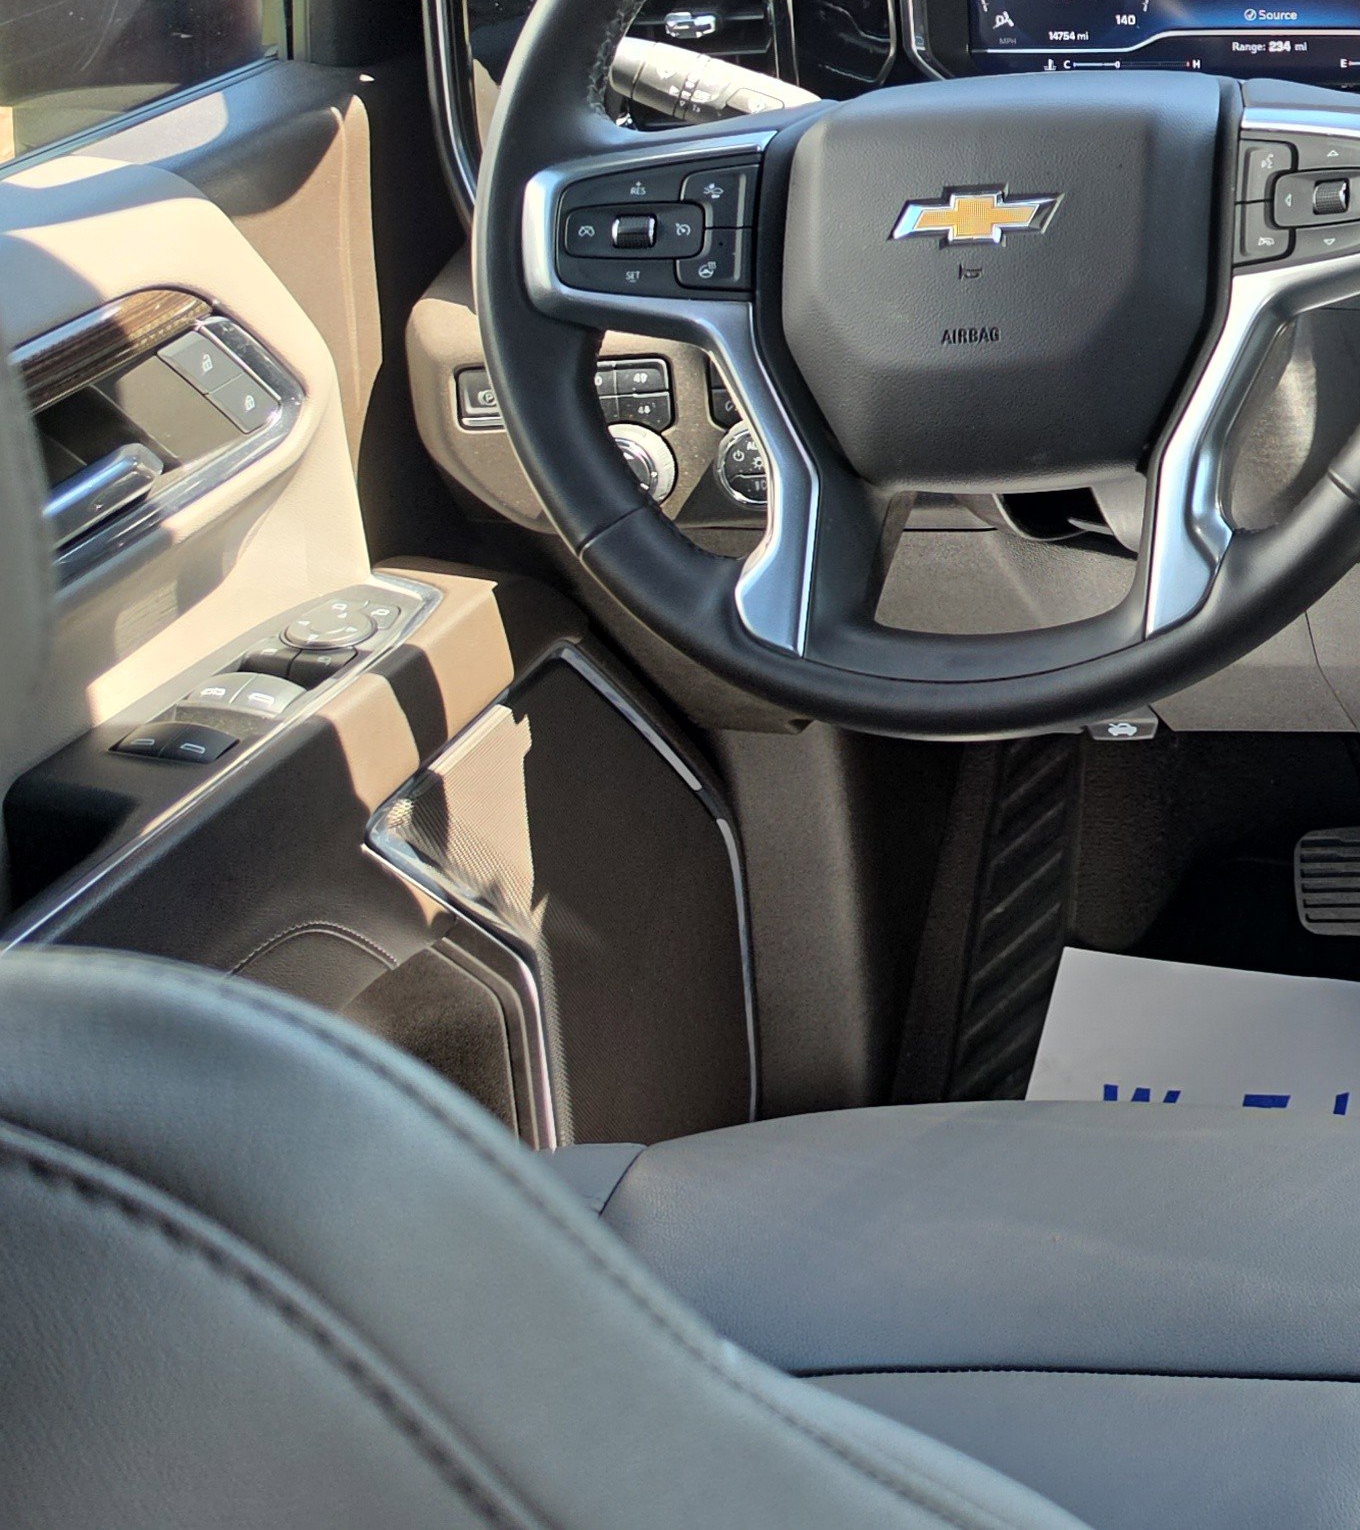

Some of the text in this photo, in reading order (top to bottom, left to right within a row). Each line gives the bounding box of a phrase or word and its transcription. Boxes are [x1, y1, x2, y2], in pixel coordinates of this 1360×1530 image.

[1115, 15, 1136, 25] 140
[1258, 10, 1298, 20] Source
[1077, 31, 1089, 40] mi
[1232, 41, 1308, 54] Range: 234 mi
[1063, 60, 1071, 69] C
[1192, 60, 1201, 69] H
[1340, 58, 1347, 68] E
[630, 185, 646, 195] RES
[626, 270, 641, 280] SET
[941, 328, 1000, 345] AIRBAG
